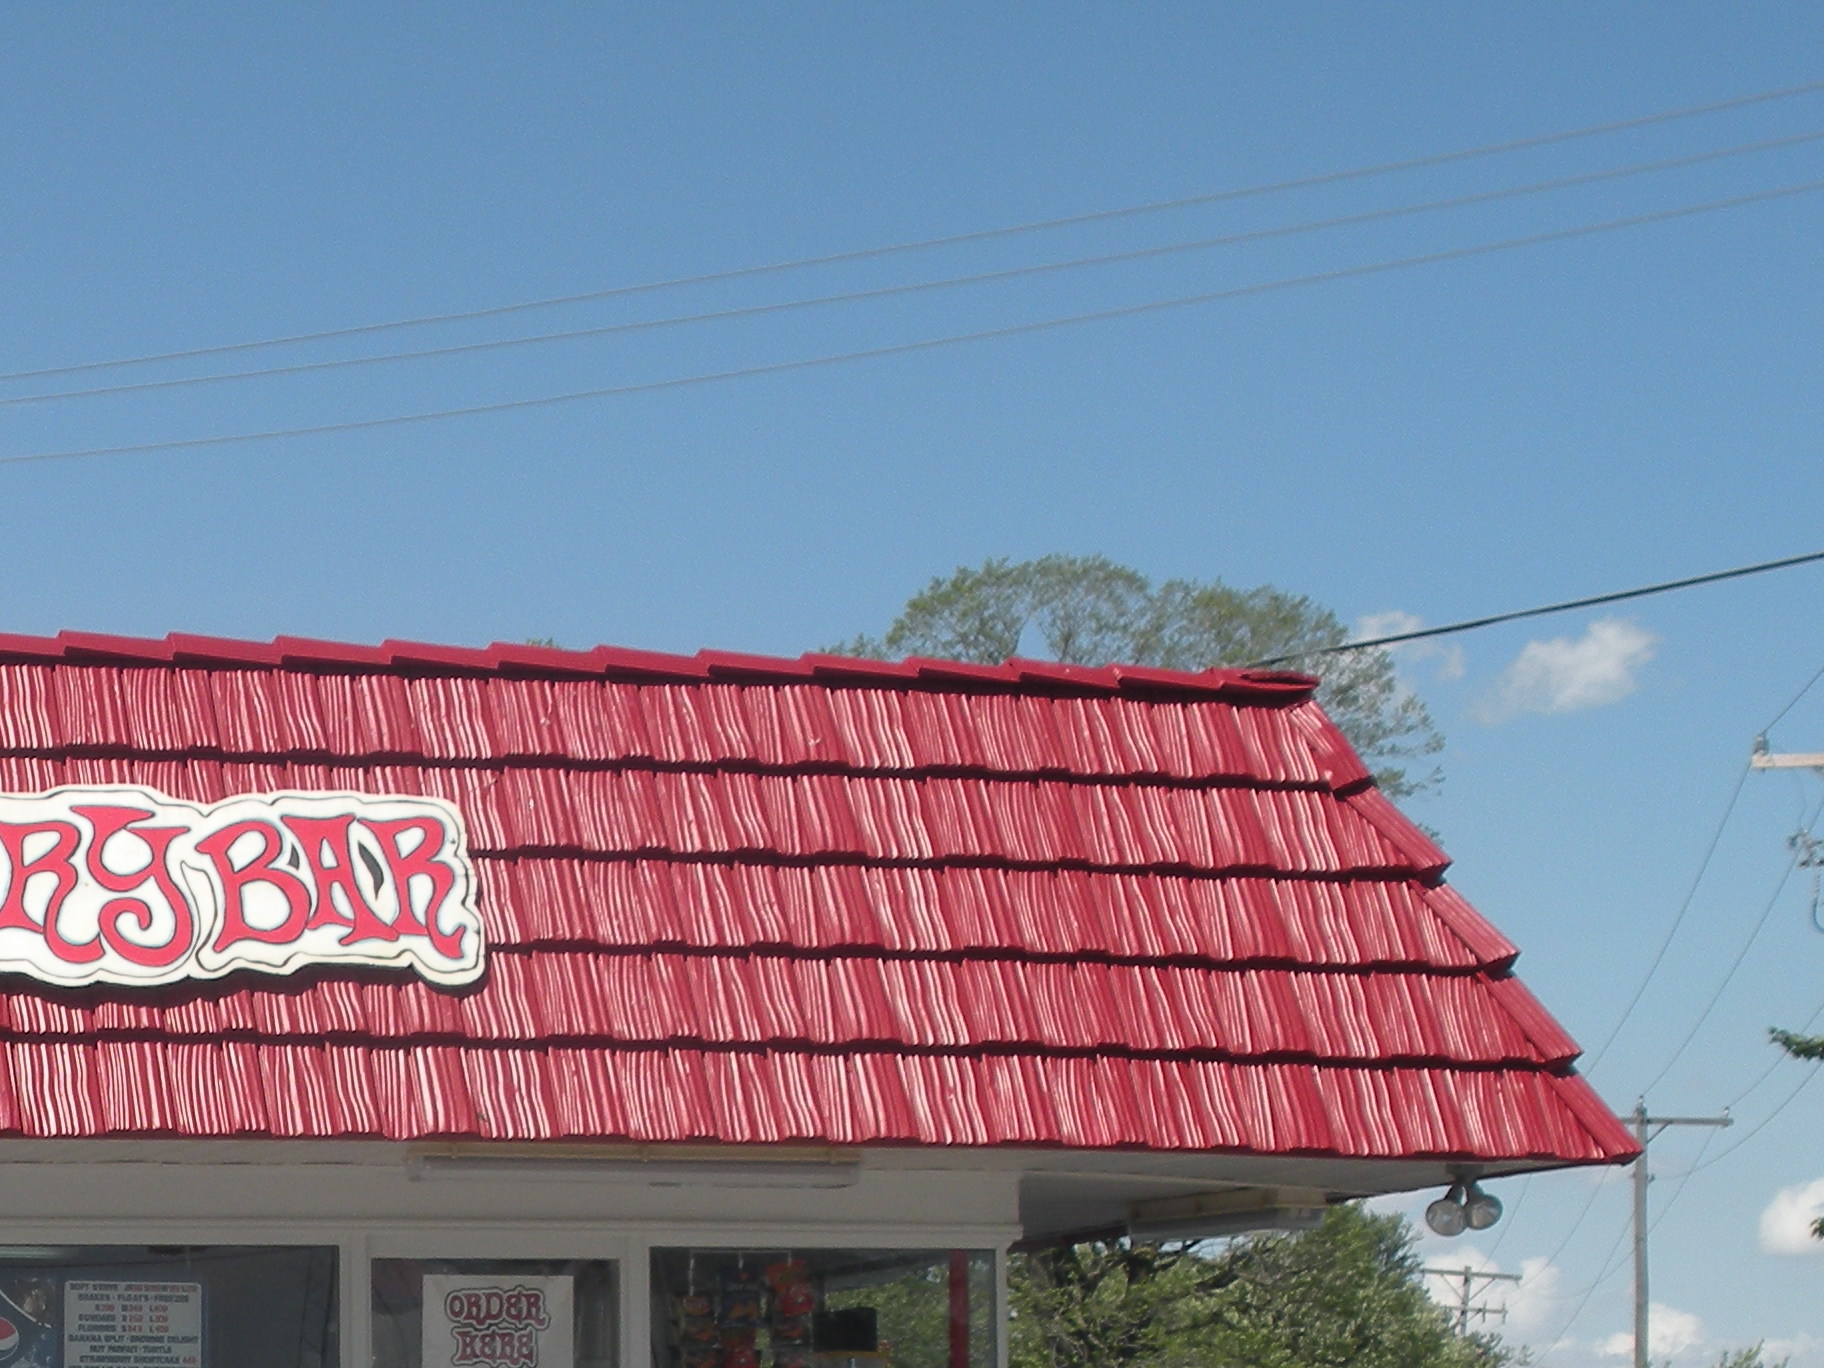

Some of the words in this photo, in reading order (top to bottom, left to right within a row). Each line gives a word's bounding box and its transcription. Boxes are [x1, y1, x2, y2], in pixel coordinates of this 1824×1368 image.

[196, 813, 466, 961] BAR
[447, 1289, 549, 1328] ORDER
[454, 1330, 537, 1368] HERE
